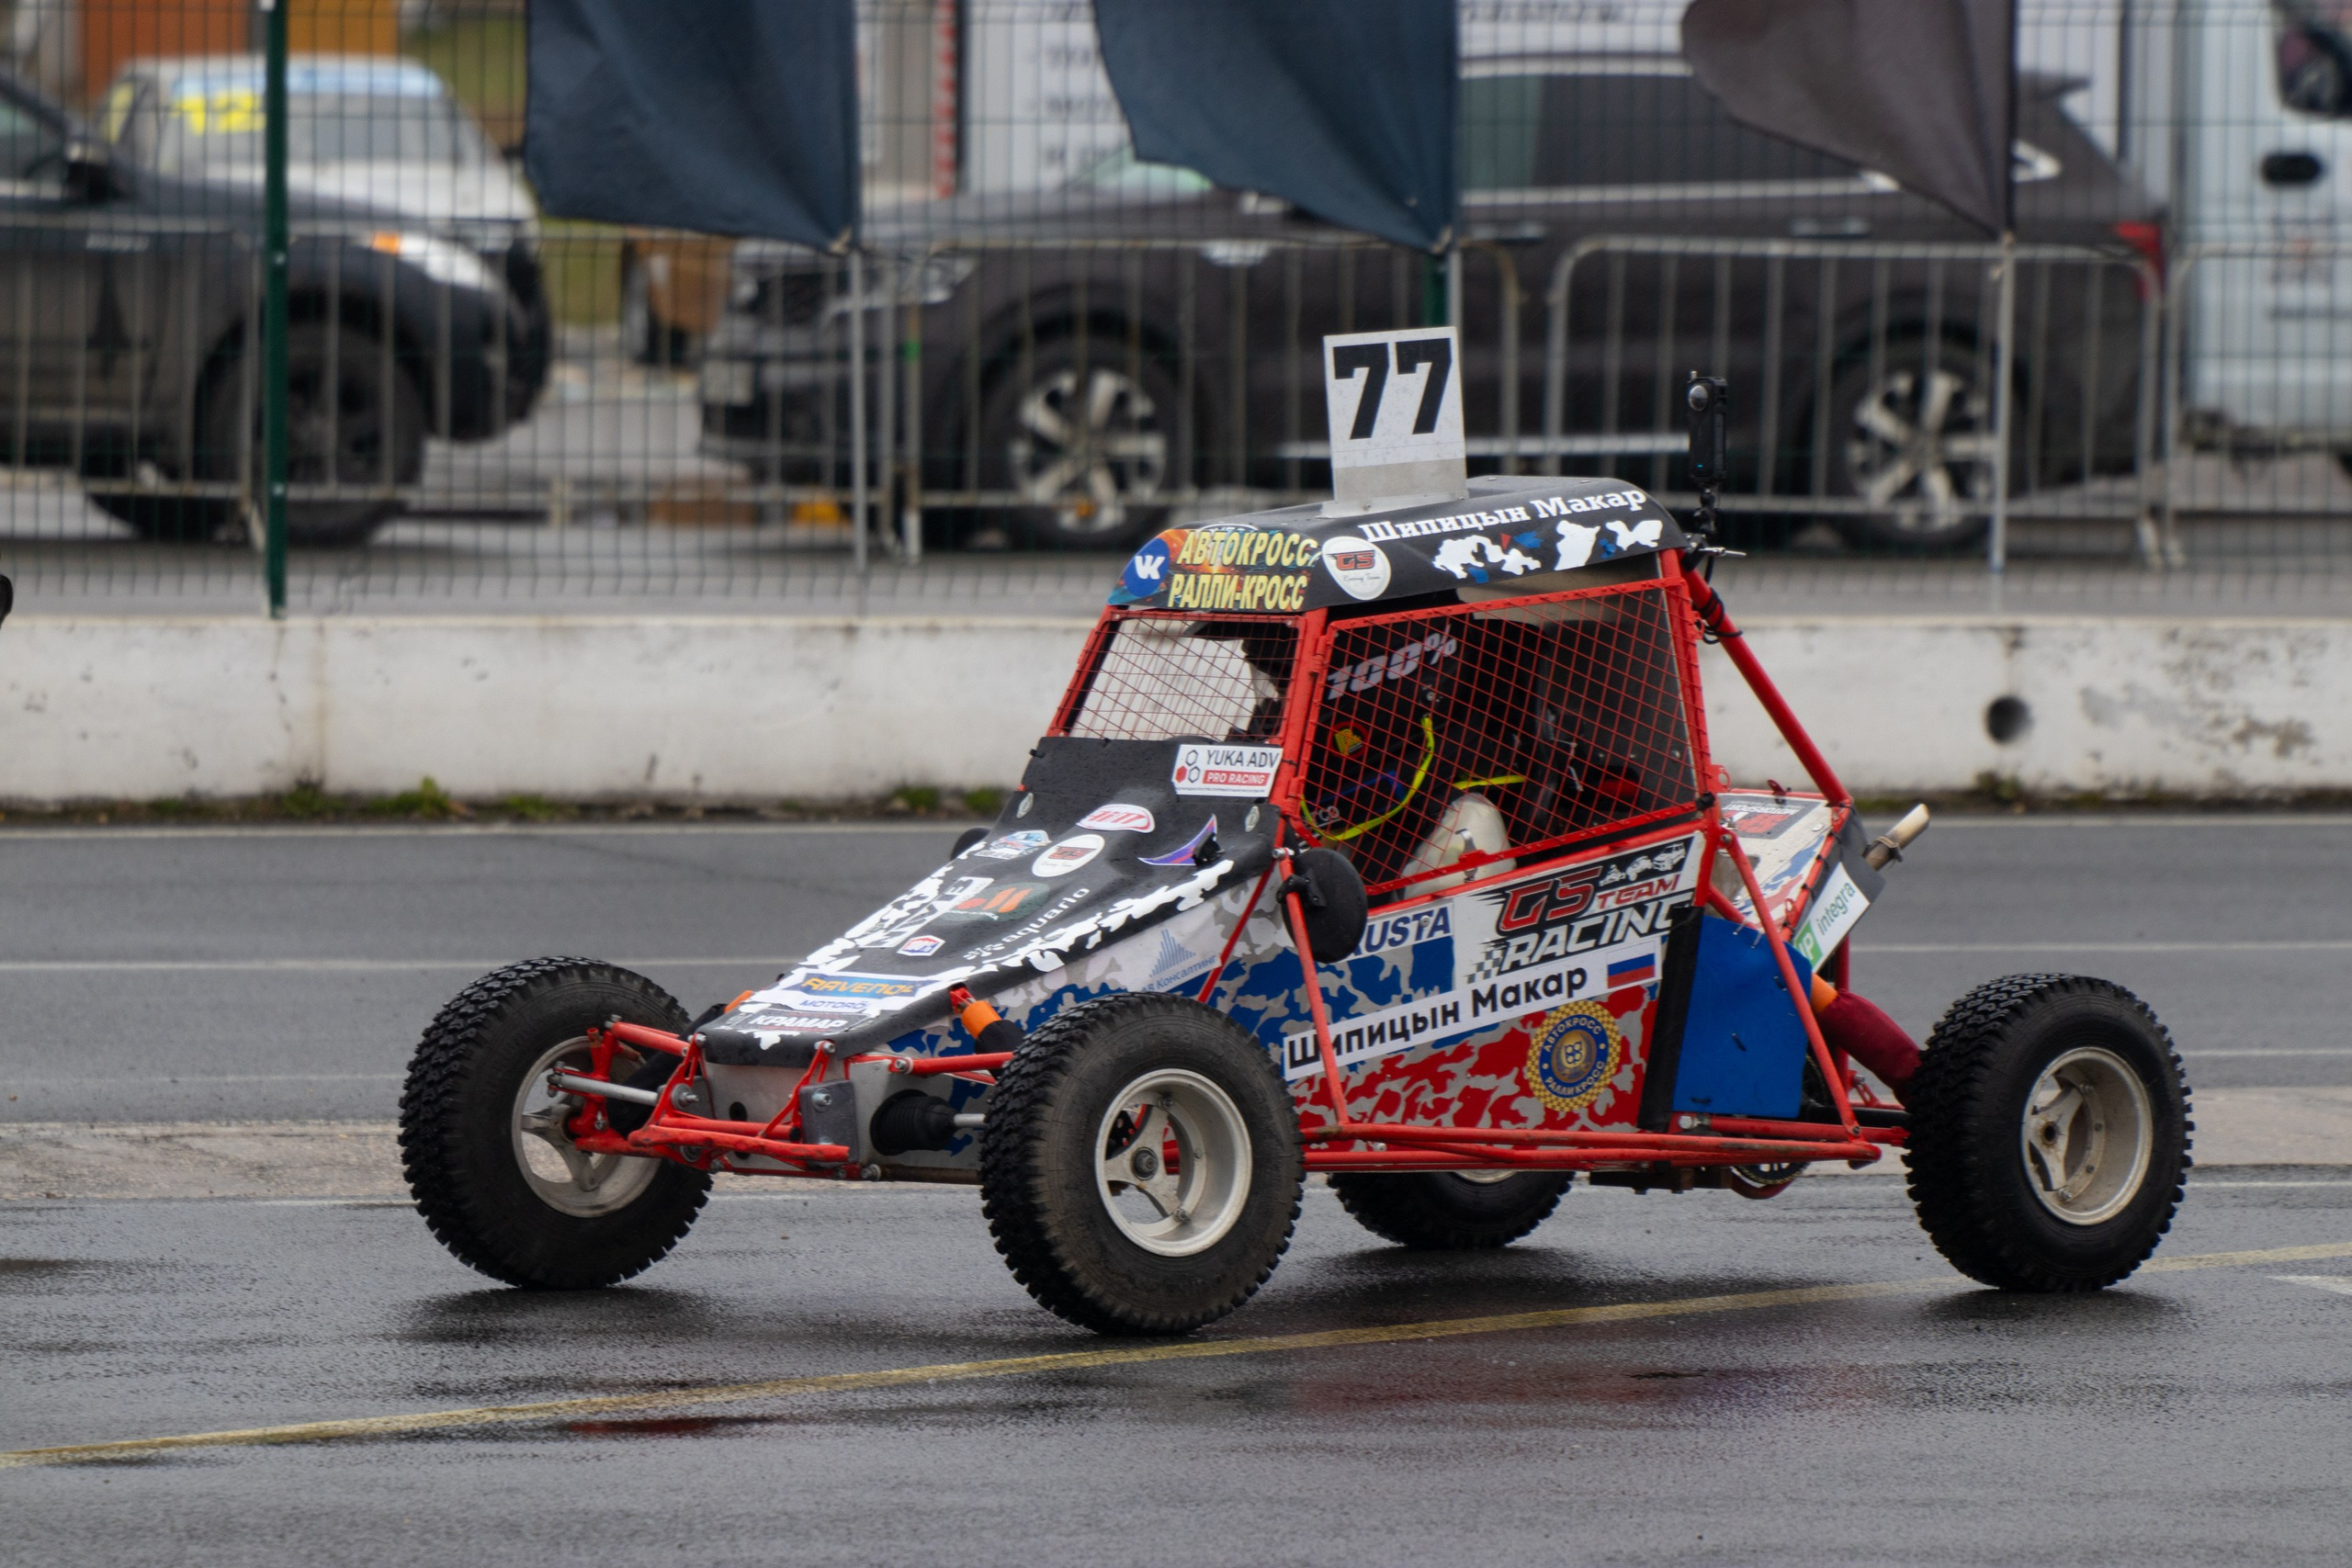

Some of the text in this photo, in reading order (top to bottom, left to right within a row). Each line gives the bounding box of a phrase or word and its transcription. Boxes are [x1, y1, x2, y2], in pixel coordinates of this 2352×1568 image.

[1332, 337, 1453, 440] 77
[1358, 490, 1647, 543] Шипицын Макар
[1168, 572, 1308, 610] РАЛЛИ-КРОСС
[1328, 625, 1458, 700] 100%
[1206, 749, 1280, 768] YUKA ADV
[1206, 772, 1266, 784] PRO RACING
[1500, 866, 1681, 933] GS TEAM
[1816, 881, 1856, 936] integra
[800, 976, 915, 996] RAVENOL
[1472, 966, 1589, 1013] Макар
[749, 1014, 849, 1030] КРАМАР
[1544, 1017, 1603, 1053] АВТОКРОСС
